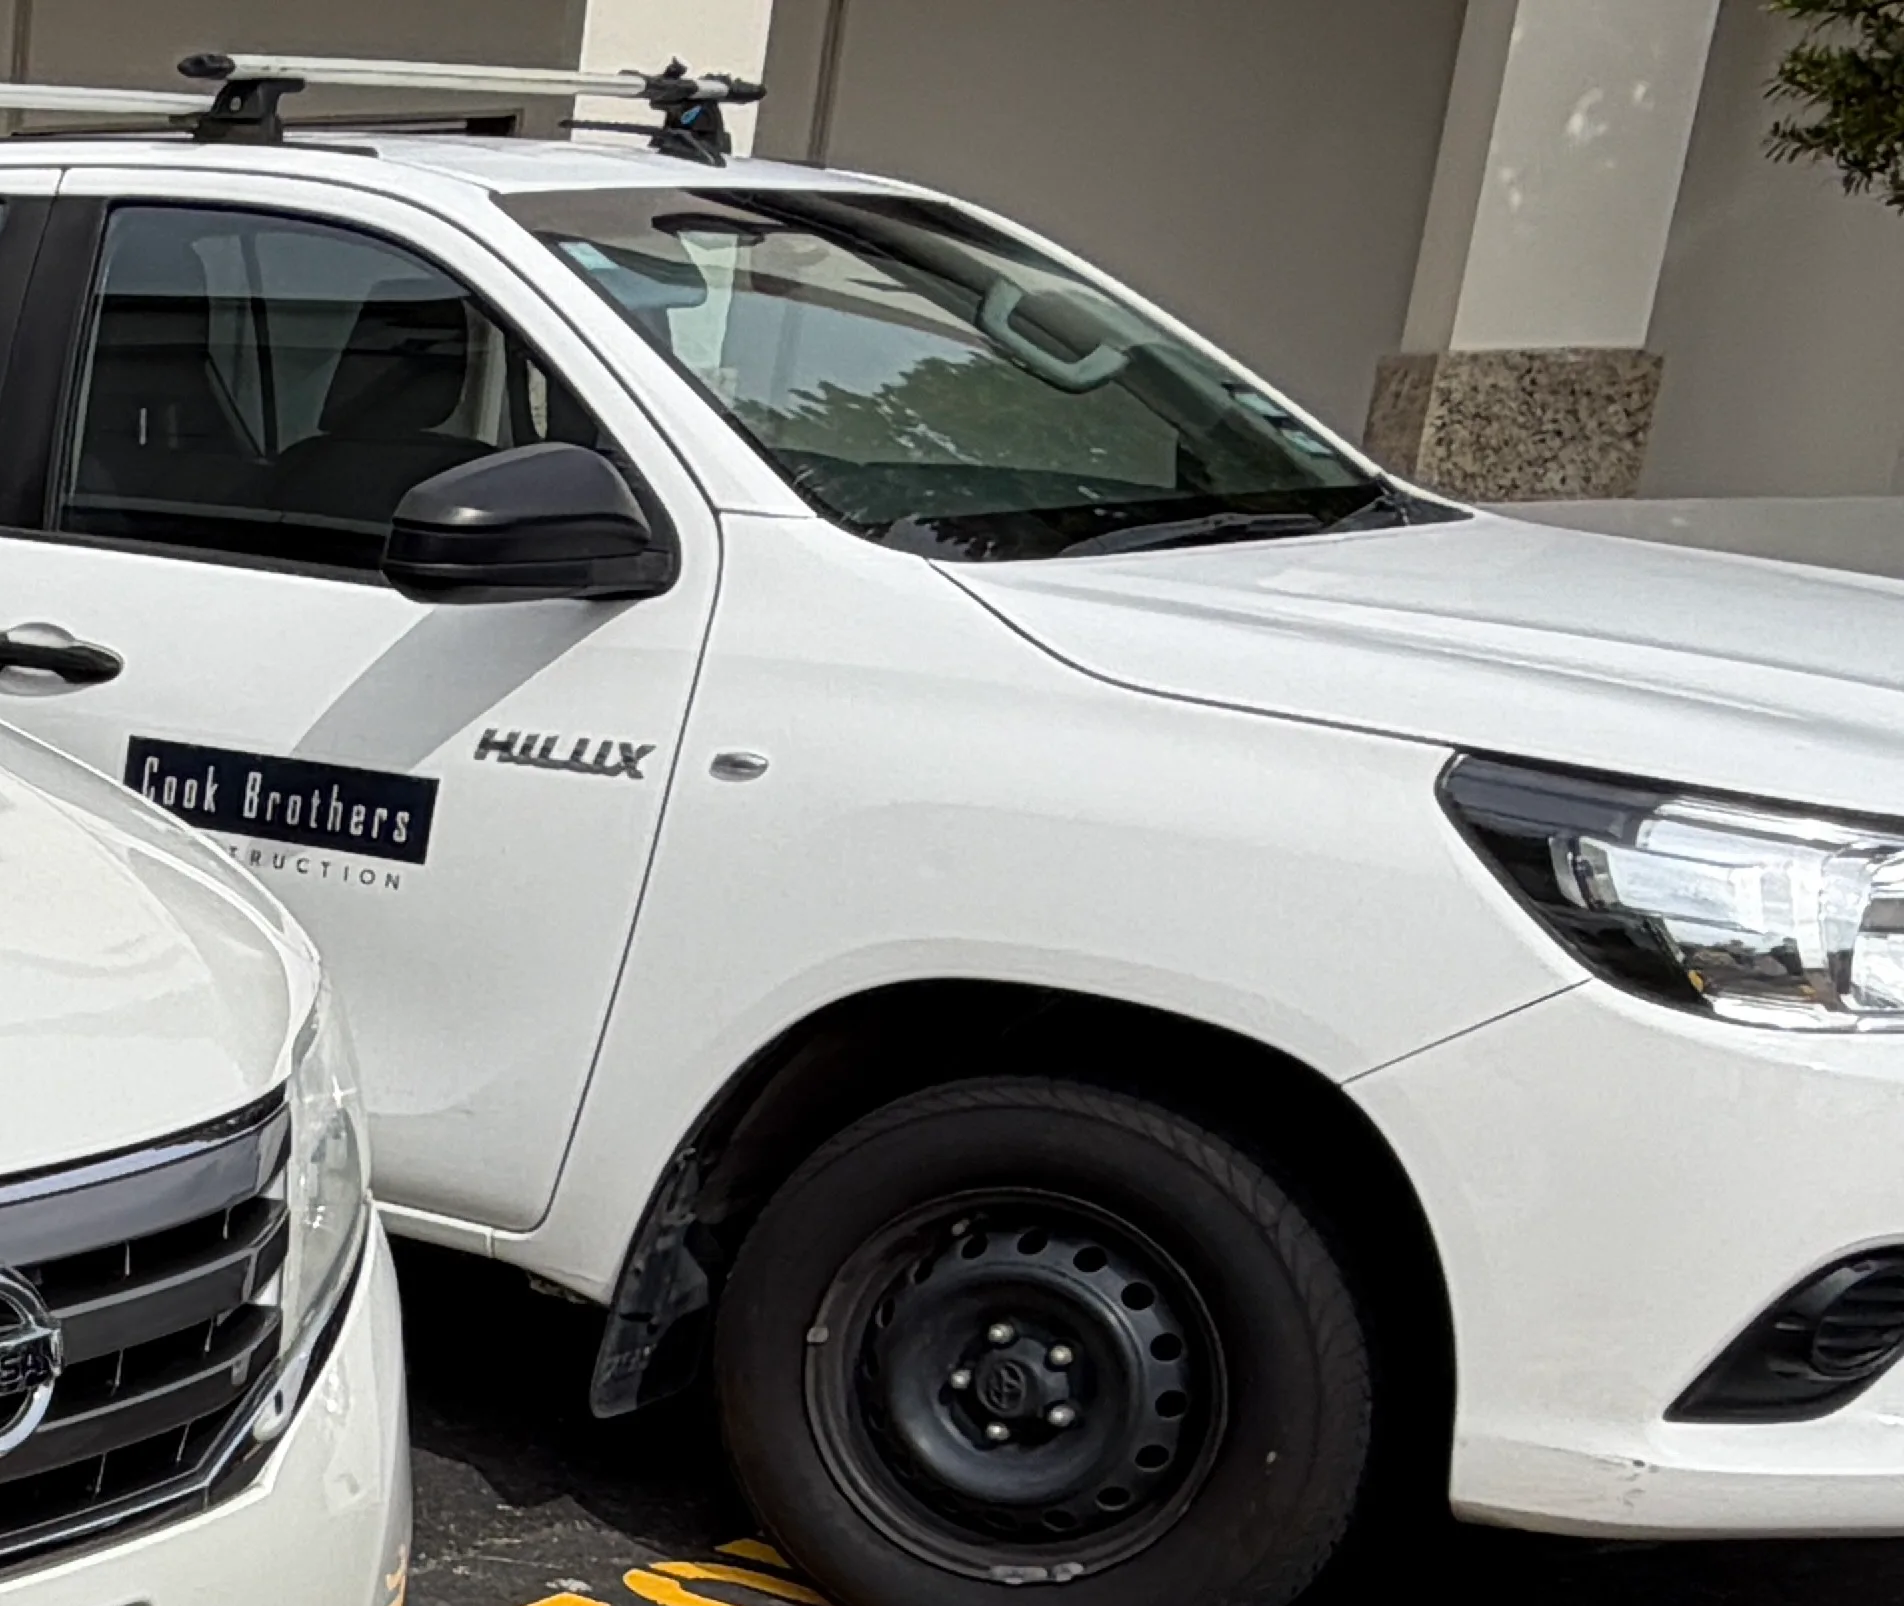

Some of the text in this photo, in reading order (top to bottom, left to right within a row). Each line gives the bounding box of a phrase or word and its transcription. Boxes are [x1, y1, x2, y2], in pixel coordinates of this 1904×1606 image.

[473, 726, 657, 780] HILUX
[141, 756, 411, 844] Cook Brothers
[228, 845, 400, 890] TRUCTION
